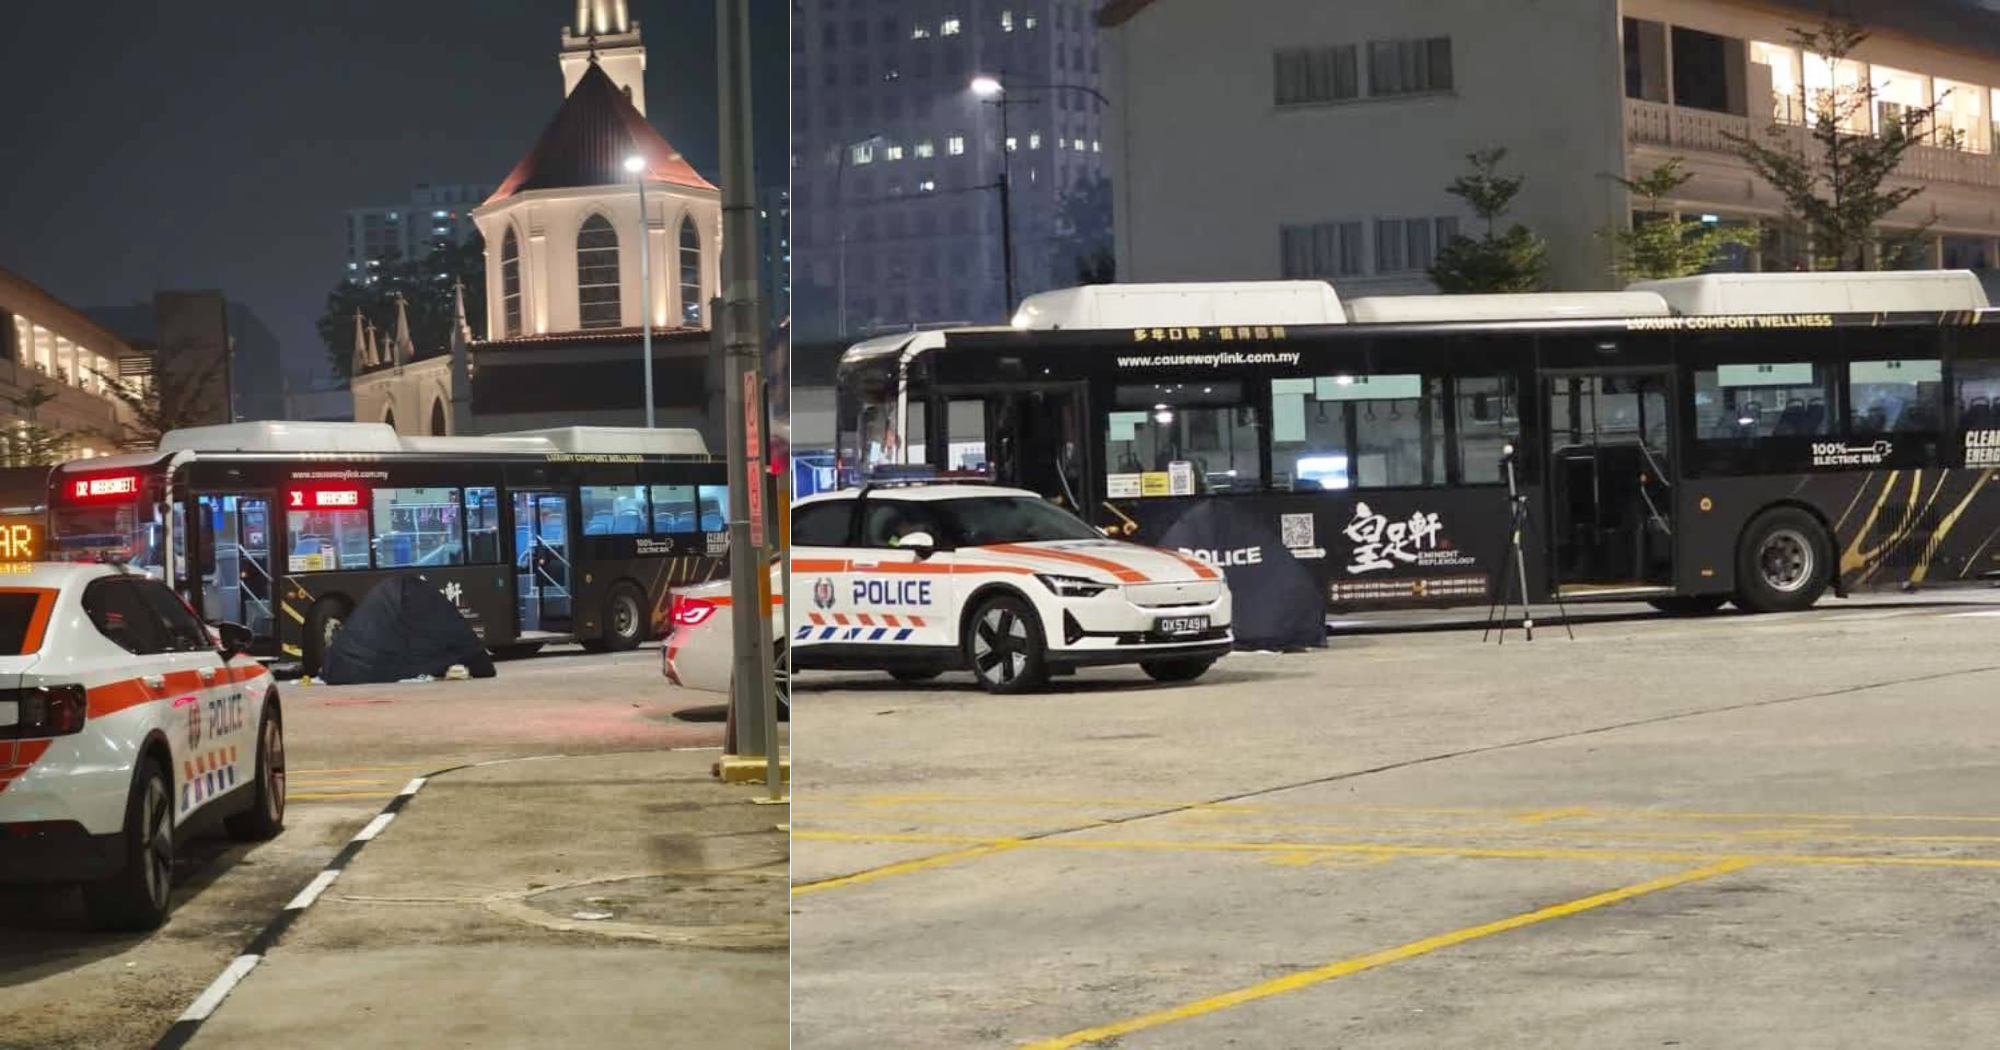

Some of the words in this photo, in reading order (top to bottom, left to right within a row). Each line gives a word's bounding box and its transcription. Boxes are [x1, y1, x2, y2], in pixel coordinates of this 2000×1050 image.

[1627, 317, 1682, 330] LUXURY
[1687, 316, 1754, 328] COMFORT
[1758, 314, 1833, 327] WELLNESS
[1117, 352, 1300, 367] www.causewaylink.com.my
[1812, 443, 1847, 455] 100%
[1814, 455, 1860, 465] ELECTRIC
[1862, 454, 1882, 463] BUS
[1418, 550, 1458, 559] EMINENT
[1418, 557, 1475, 566] REFLEXOLOGY
[853, 580, 931, 605] POLICE
[209, 693, 243, 739] POLICE
